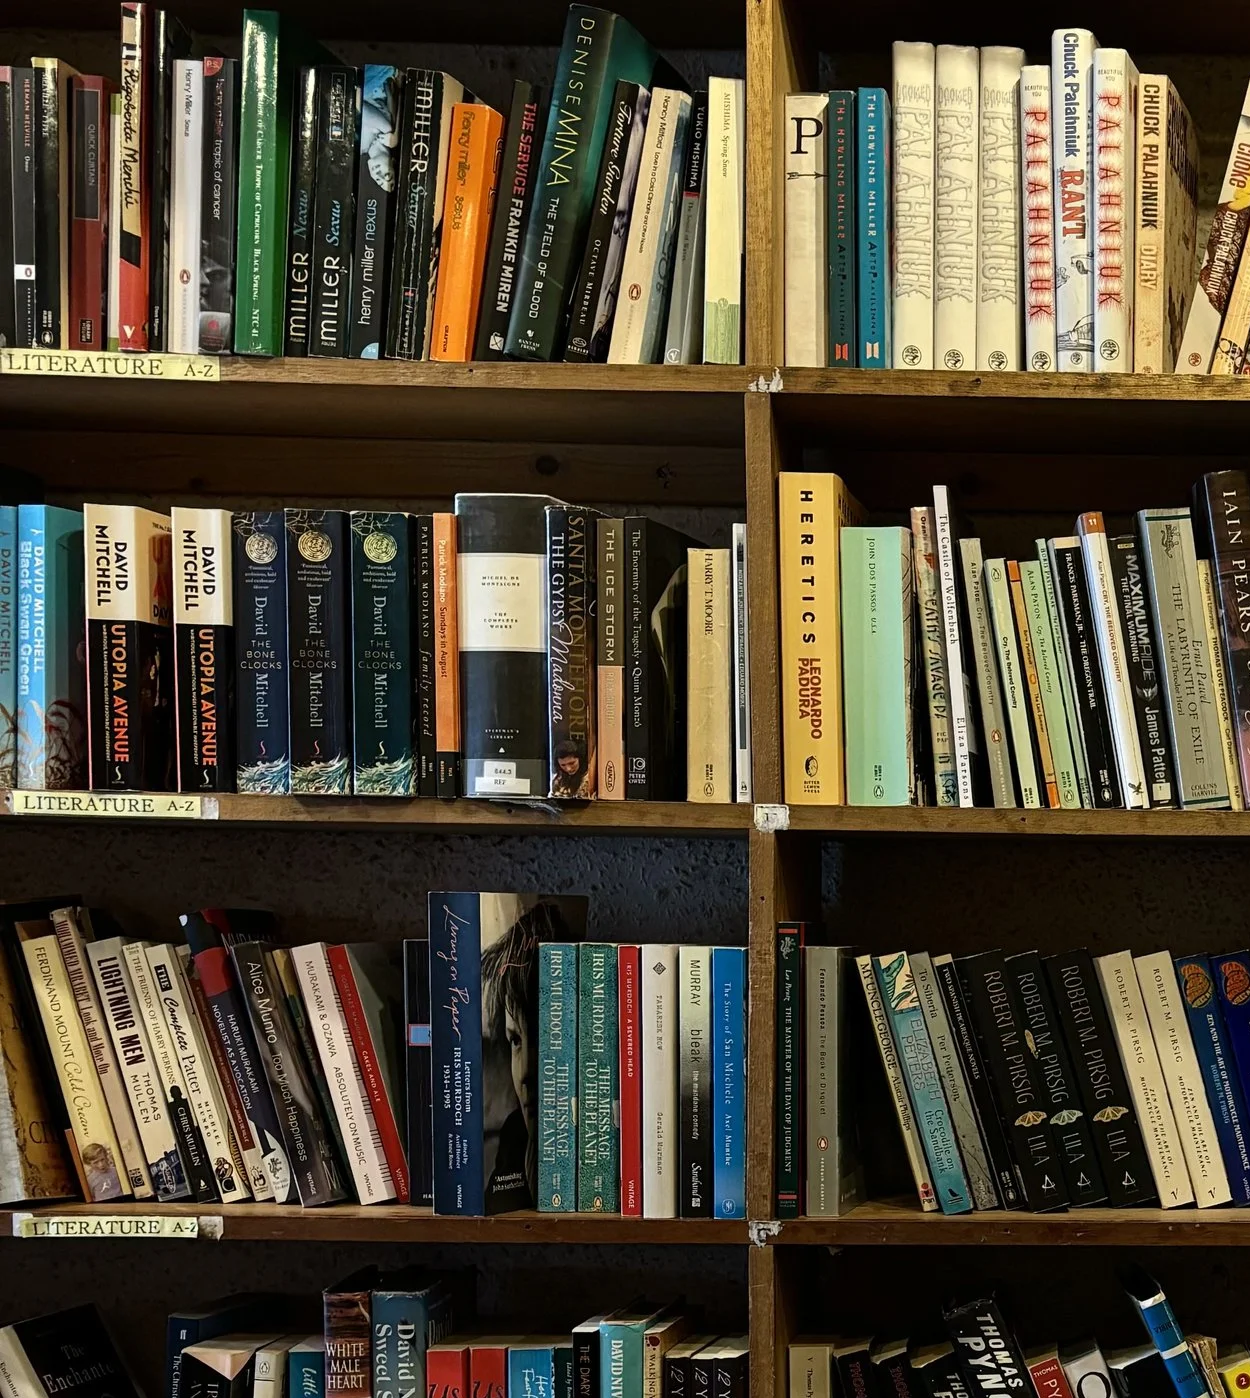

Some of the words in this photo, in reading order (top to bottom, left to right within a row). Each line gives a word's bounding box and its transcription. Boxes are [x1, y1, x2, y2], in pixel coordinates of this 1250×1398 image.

[566, 17, 596, 106] DENISE
[1062, 33, 1080, 79] Chuck
[121, 67, 135, 143] Rigoberta
[1063, 82, 1080, 159] Palahniuk
[546, 109, 582, 187] MINA
[790, 117, 823, 155] P
[123, 145, 139, 209] Menchú
[1025, 111, 1052, 319] PALAHNIUK
[1060, 169, 1086, 240] RANT
[8, 358, 164, 377] LITERATURE
[184, 364, 215, 378] A-Z
[1222, 490, 1242, 545] IAIN
[95, 524, 112, 607] MITCHELL
[114, 540, 129, 592] DAVID
[605, 529, 615, 572] THE
[799, 489, 816, 645] HERETICS
[605, 572, 615, 598] ICE
[255, 596, 268, 636] David
[605, 604, 615, 663] STORM
[111, 624, 128, 692] UTOPIA
[240, 661, 282, 670] CLOCKS
[246, 650, 276, 659] BONE
[251, 639, 271, 648] THE
[255, 672, 269, 729] Mitchell
[798, 657, 810, 721] PADURA
[809, 657, 823, 741] LEONARDO
[112, 695, 129, 763] AVENUE
[24, 795, 155, 813] LITERATURE
[167, 798, 195, 812] A-Z
[155, 964, 172, 992] THE
[248, 961, 265, 995] Alice
[689, 959, 701, 1007] MURRAY
[96, 956, 135, 1031] LIGHTNING
[119, 1034, 143, 1067] MEN
[163, 996, 188, 1055] Complete
[256, 995, 278, 1045] Munro
[690, 1029, 701, 1064] bleak
[130, 1074, 151, 1124] MULLEN
[141, 1073, 162, 1122] THOMAS
[181, 1053, 202, 1095] Patter
[32, 1221, 161, 1235] LITERATURE
[325, 1342, 365, 1356] WHITE
[330, 1360, 361, 1373] MALE
[396, 1324, 416, 1383] David
[976, 1313, 1024, 1389] THOMAS
[327, 1374, 363, 1389] HEART
